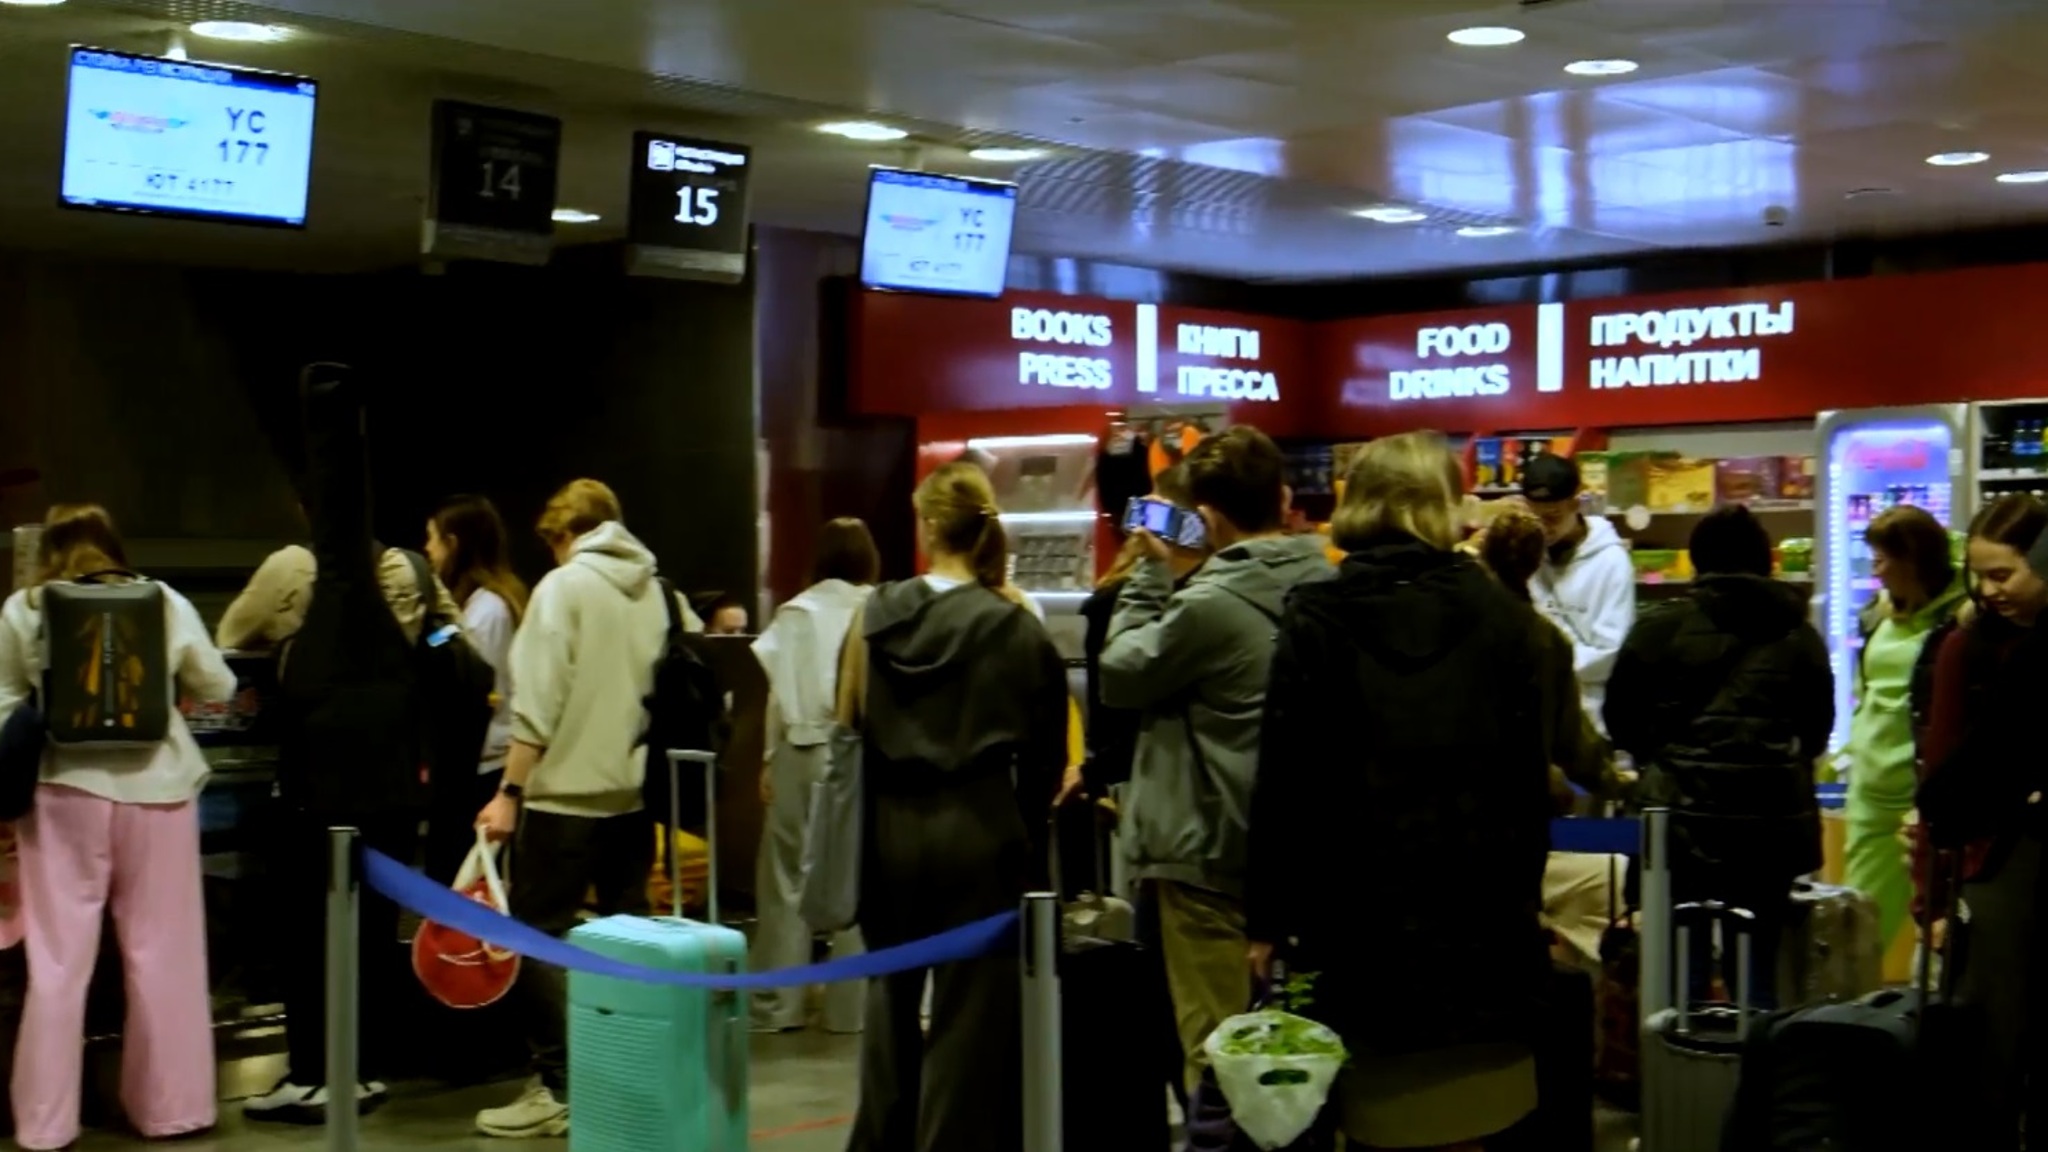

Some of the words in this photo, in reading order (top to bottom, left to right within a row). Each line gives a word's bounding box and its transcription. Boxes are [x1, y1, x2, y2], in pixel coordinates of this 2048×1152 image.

[225, 106, 266, 133] YC
[218, 139, 269, 165] 177
[478, 160, 522, 200] 14
[674, 185, 720, 226] 15
[954, 233, 985, 252] 177
[1011, 307, 1112, 346] BOOKS
[1416, 323, 1511, 358] FOOD
[1590, 301, 1794, 348] ПРОДУКТЫ
[1019, 352, 1112, 389] PRESS
[1177, 365, 1280, 401] ПРЕССА
[1389, 364, 1511, 400] DRINKS
[1590, 348, 1760, 389] НАПИТКИ
